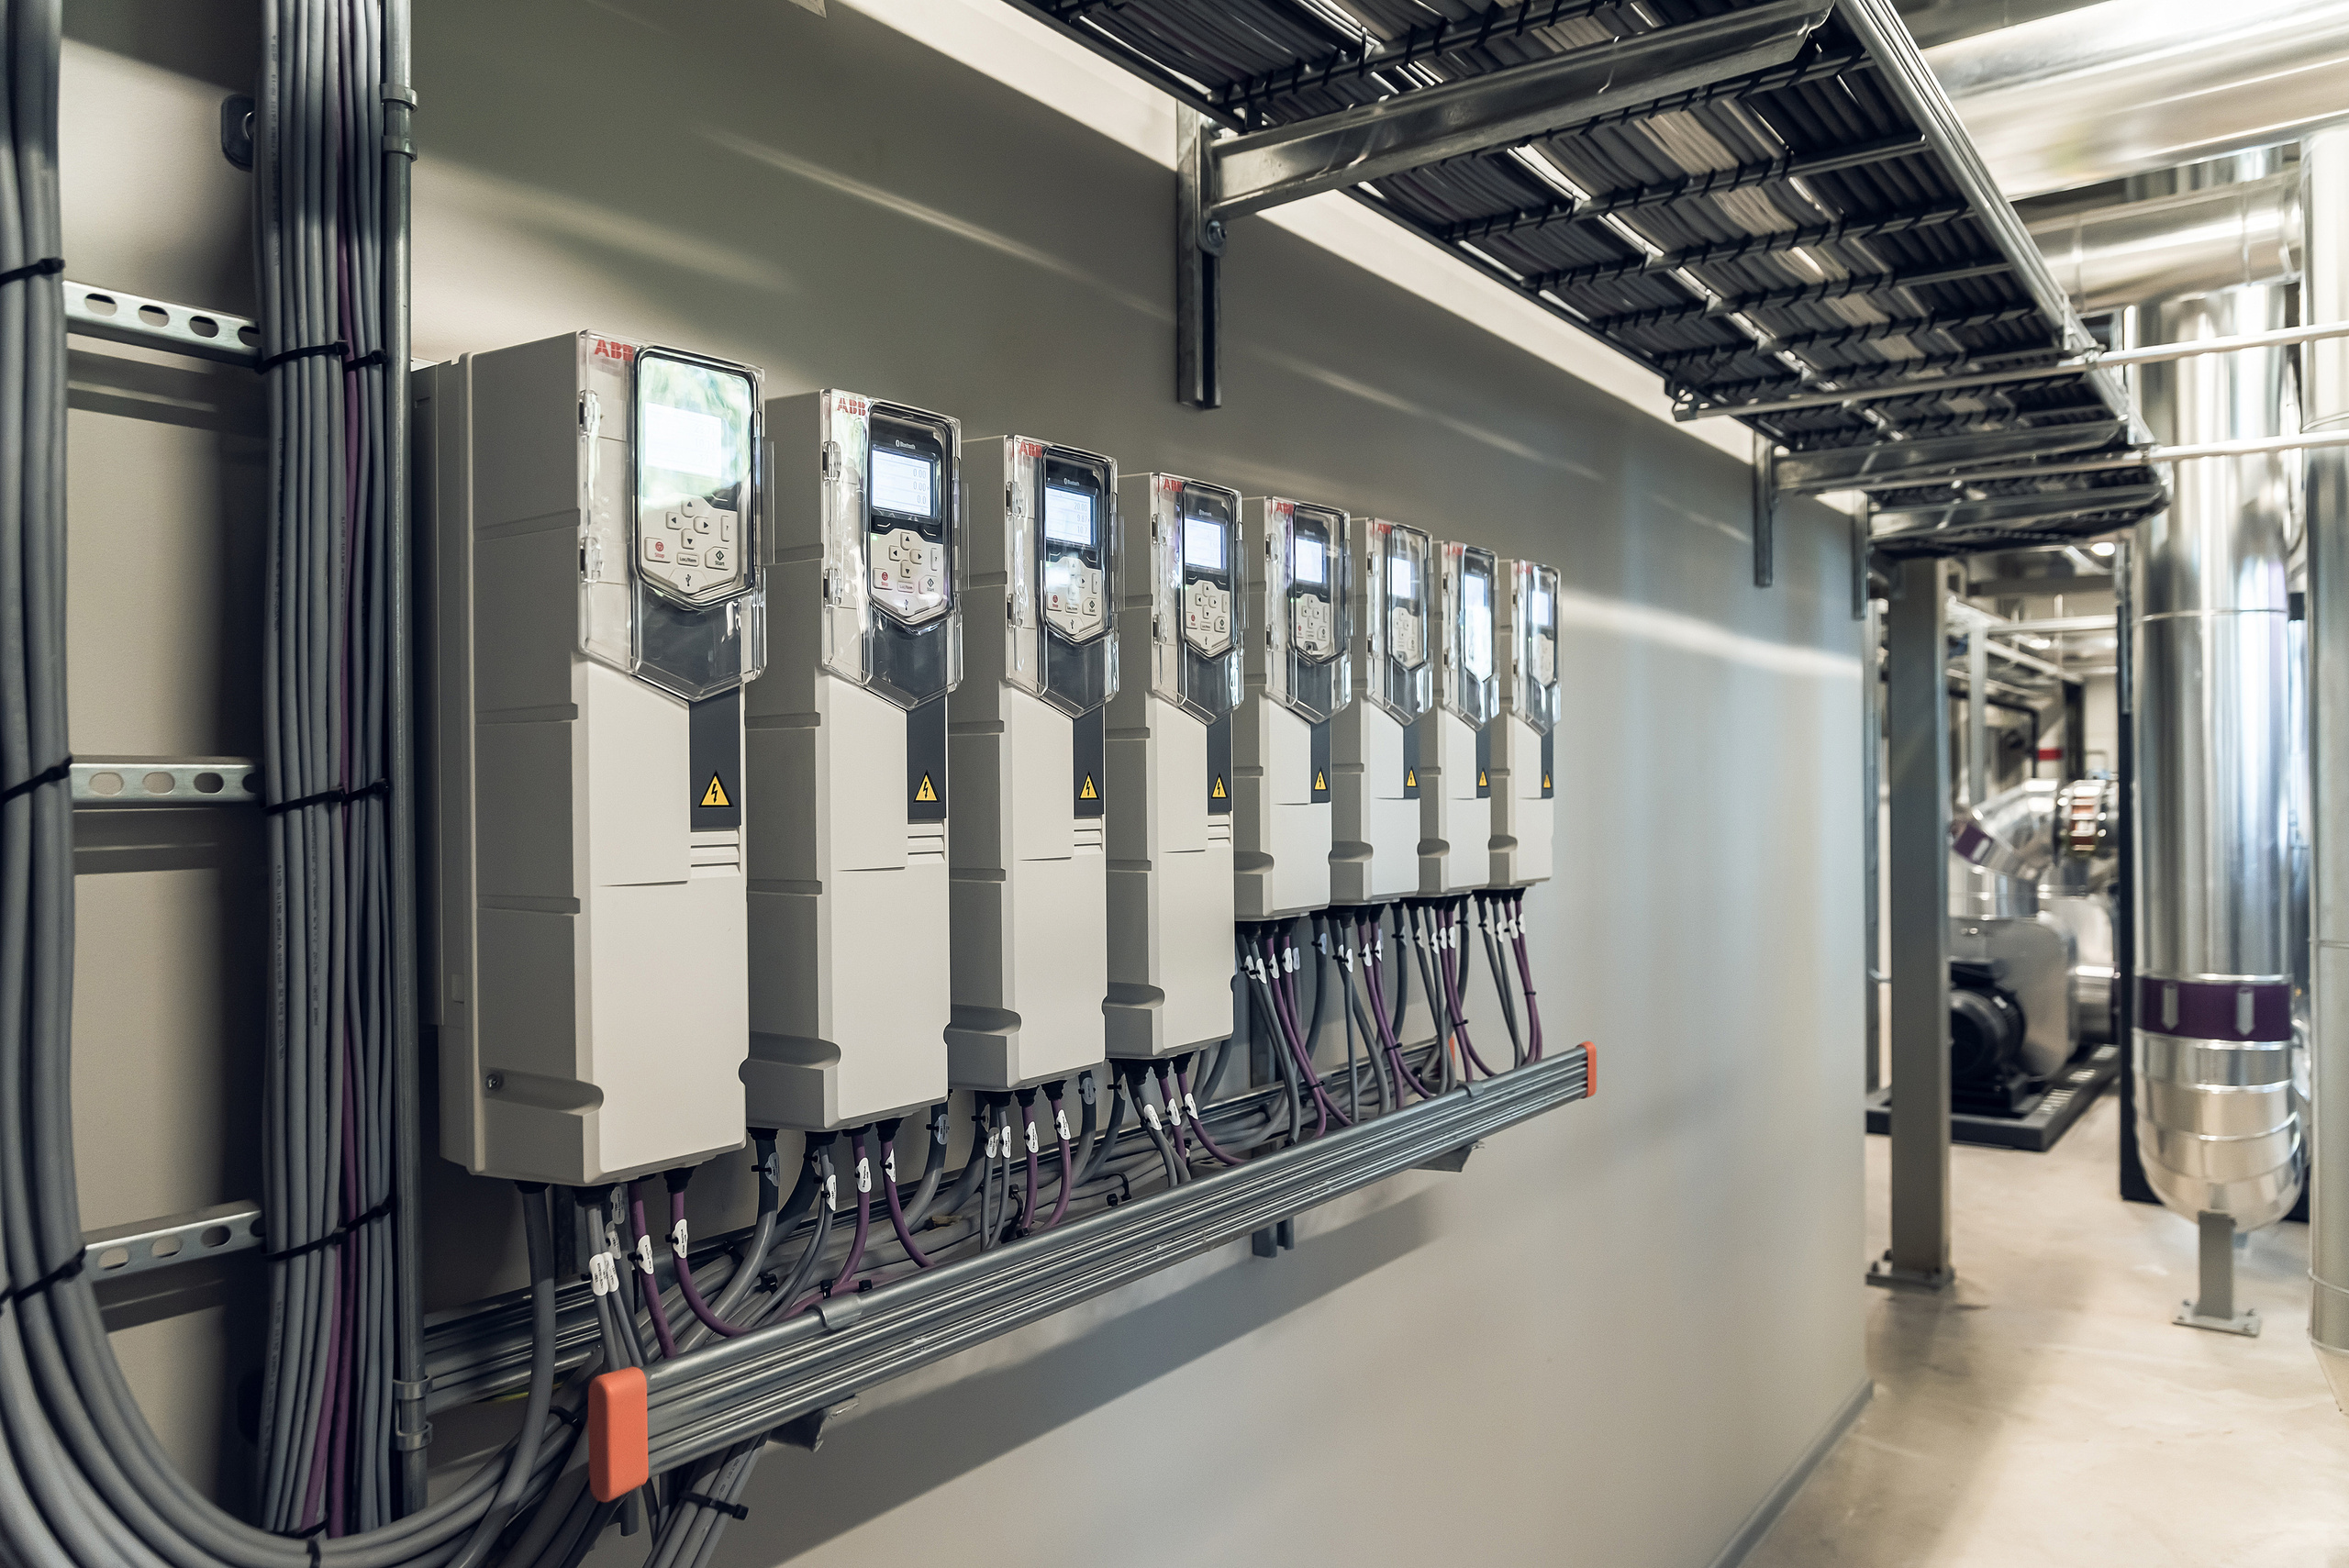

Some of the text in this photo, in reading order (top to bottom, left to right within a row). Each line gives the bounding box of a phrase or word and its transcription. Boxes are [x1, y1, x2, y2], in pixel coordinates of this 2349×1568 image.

[594, 339, 633, 361] ABB
[837, 397, 865, 416] ABB
[1019, 441, 1042, 458] ABB
[1163, 478, 1182, 493] ABB
[1276, 502, 1294, 516] ABB
